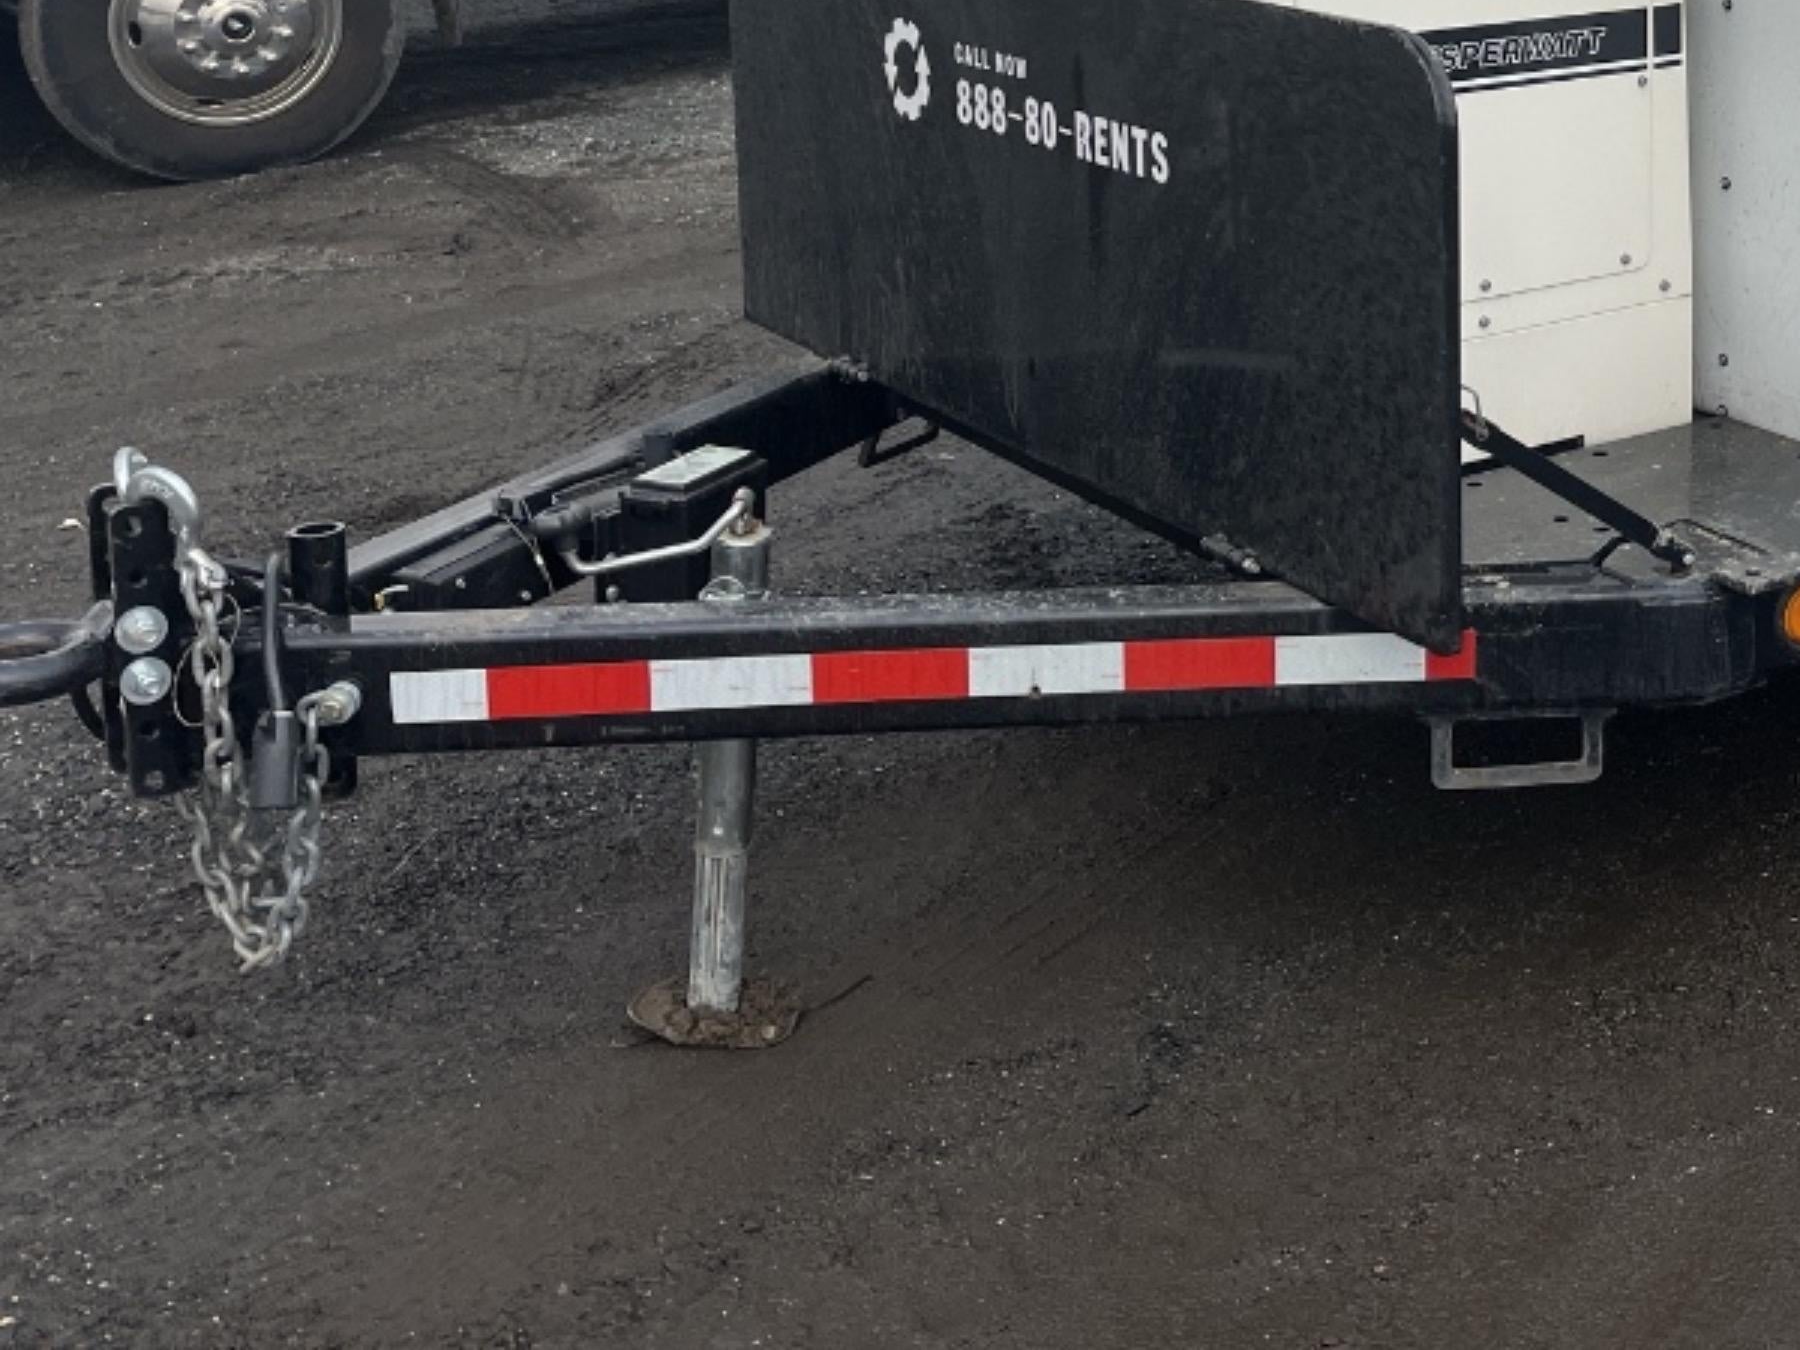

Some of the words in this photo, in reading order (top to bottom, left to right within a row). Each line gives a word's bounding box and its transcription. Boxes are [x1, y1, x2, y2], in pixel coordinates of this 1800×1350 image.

[952, 40, 992, 71] CALL
[994, 50, 1027, 79] NOW
[956, 77, 1170, 185] 888-80-RENTS
